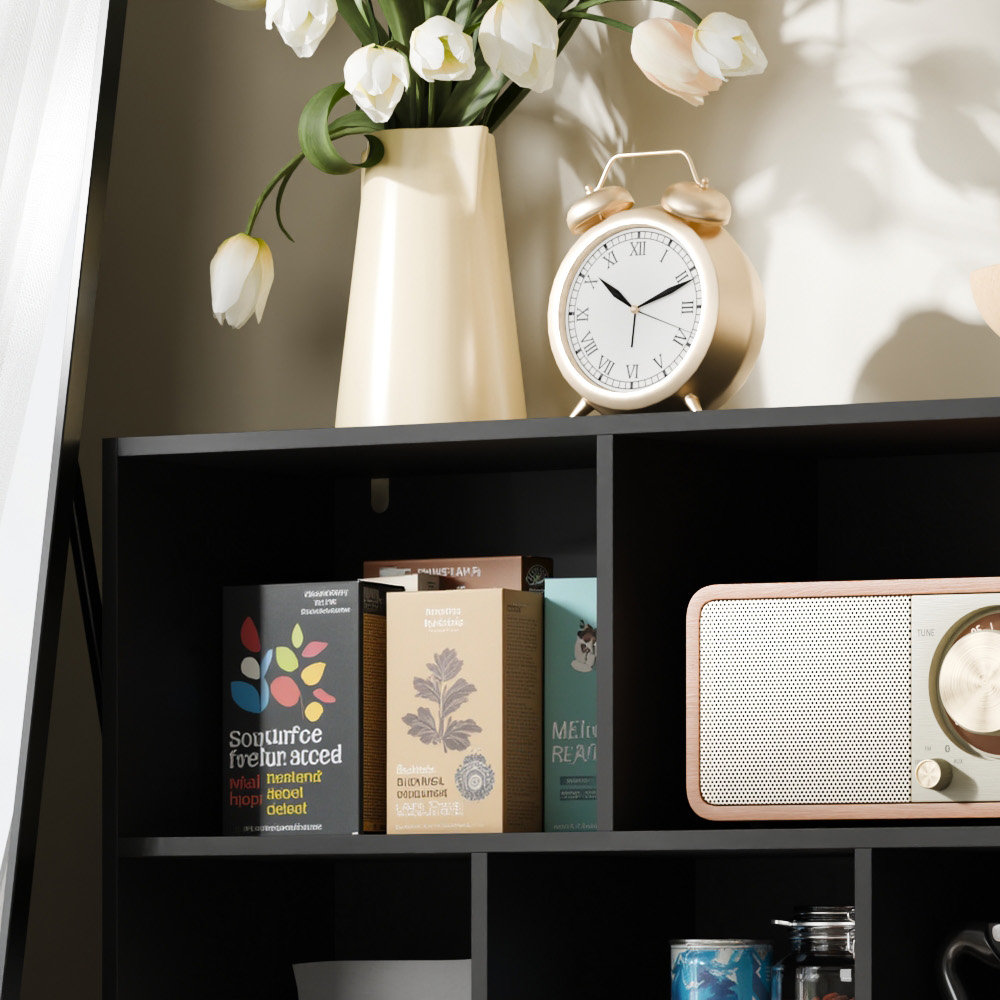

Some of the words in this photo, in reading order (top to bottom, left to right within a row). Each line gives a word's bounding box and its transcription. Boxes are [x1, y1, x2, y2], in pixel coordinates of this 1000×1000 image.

[630, 241, 646, 256] XII
[660, 249, 668, 263] I
[602, 250, 618, 269] XI
[584, 274, 598, 290] X
[675, 270, 689, 284] II
[576, 307, 589, 322] IX
[681, 301, 694, 314] III
[580, 330, 599, 357] VIII
[672, 327, 687, 347] IV
[598, 354, 616, 376] VII
[653, 353, 663, 369] V
[626, 364, 639, 379] VI
[917, 628, 935, 638] TUNE
